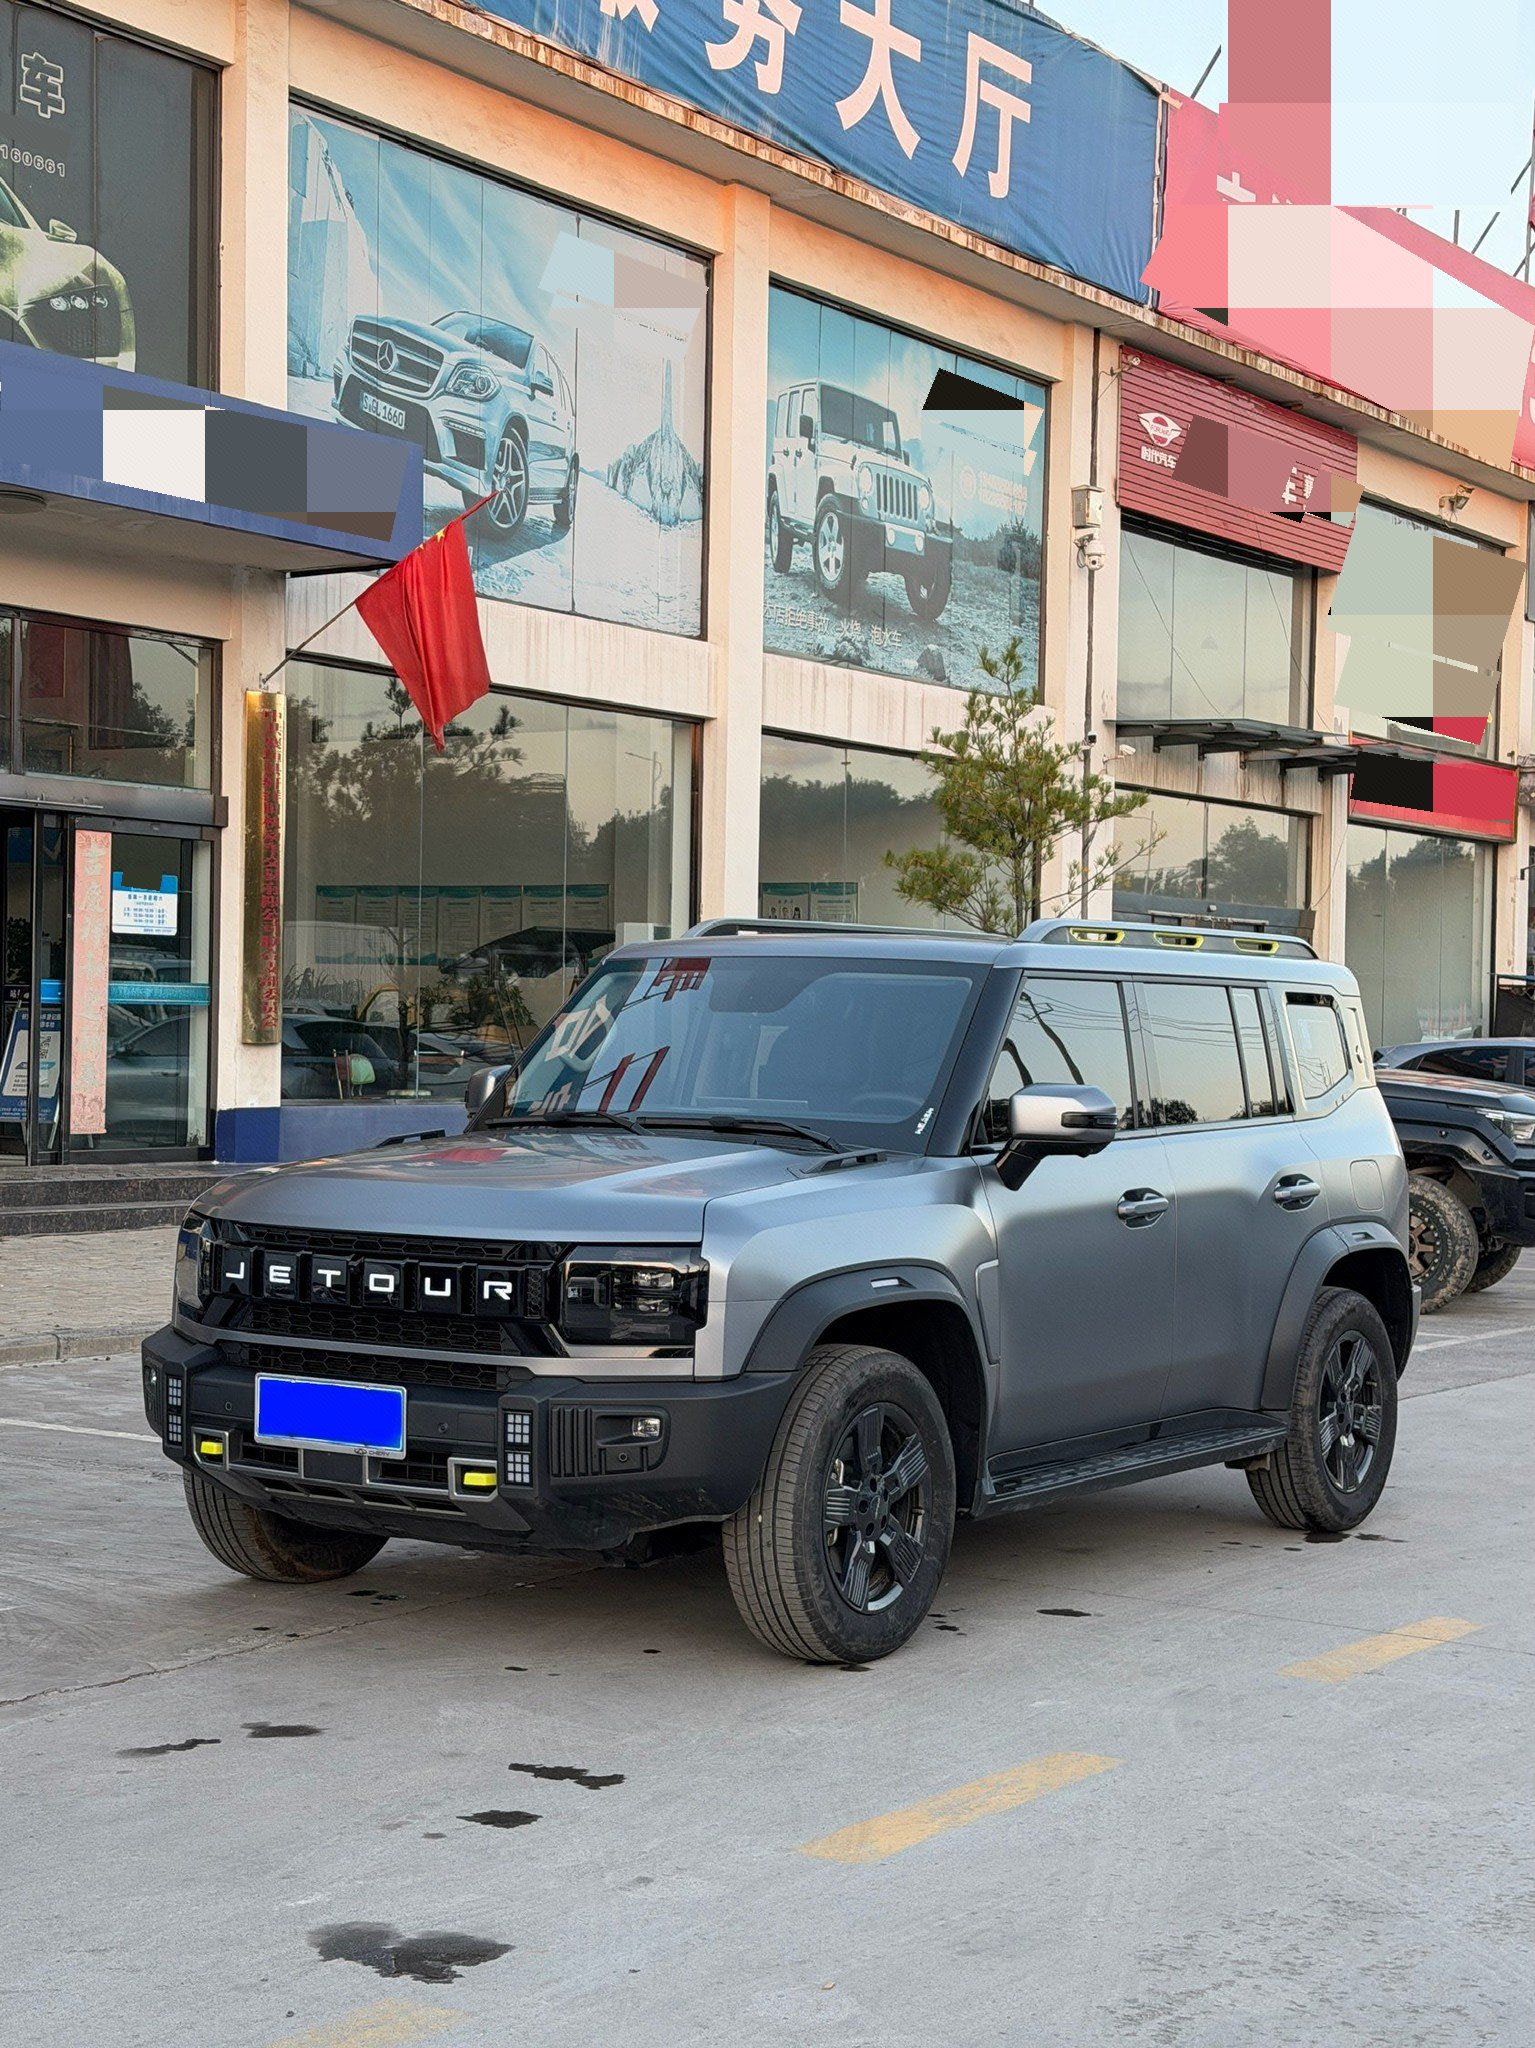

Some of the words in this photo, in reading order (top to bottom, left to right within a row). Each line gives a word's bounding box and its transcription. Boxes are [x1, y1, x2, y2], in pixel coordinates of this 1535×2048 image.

[20, 52, 65, 118] 车
[600, 0, 1033, 199] 务大厅
[382, 404, 405, 427] 1660
[225, 1262, 513, 1300] JETOUR
